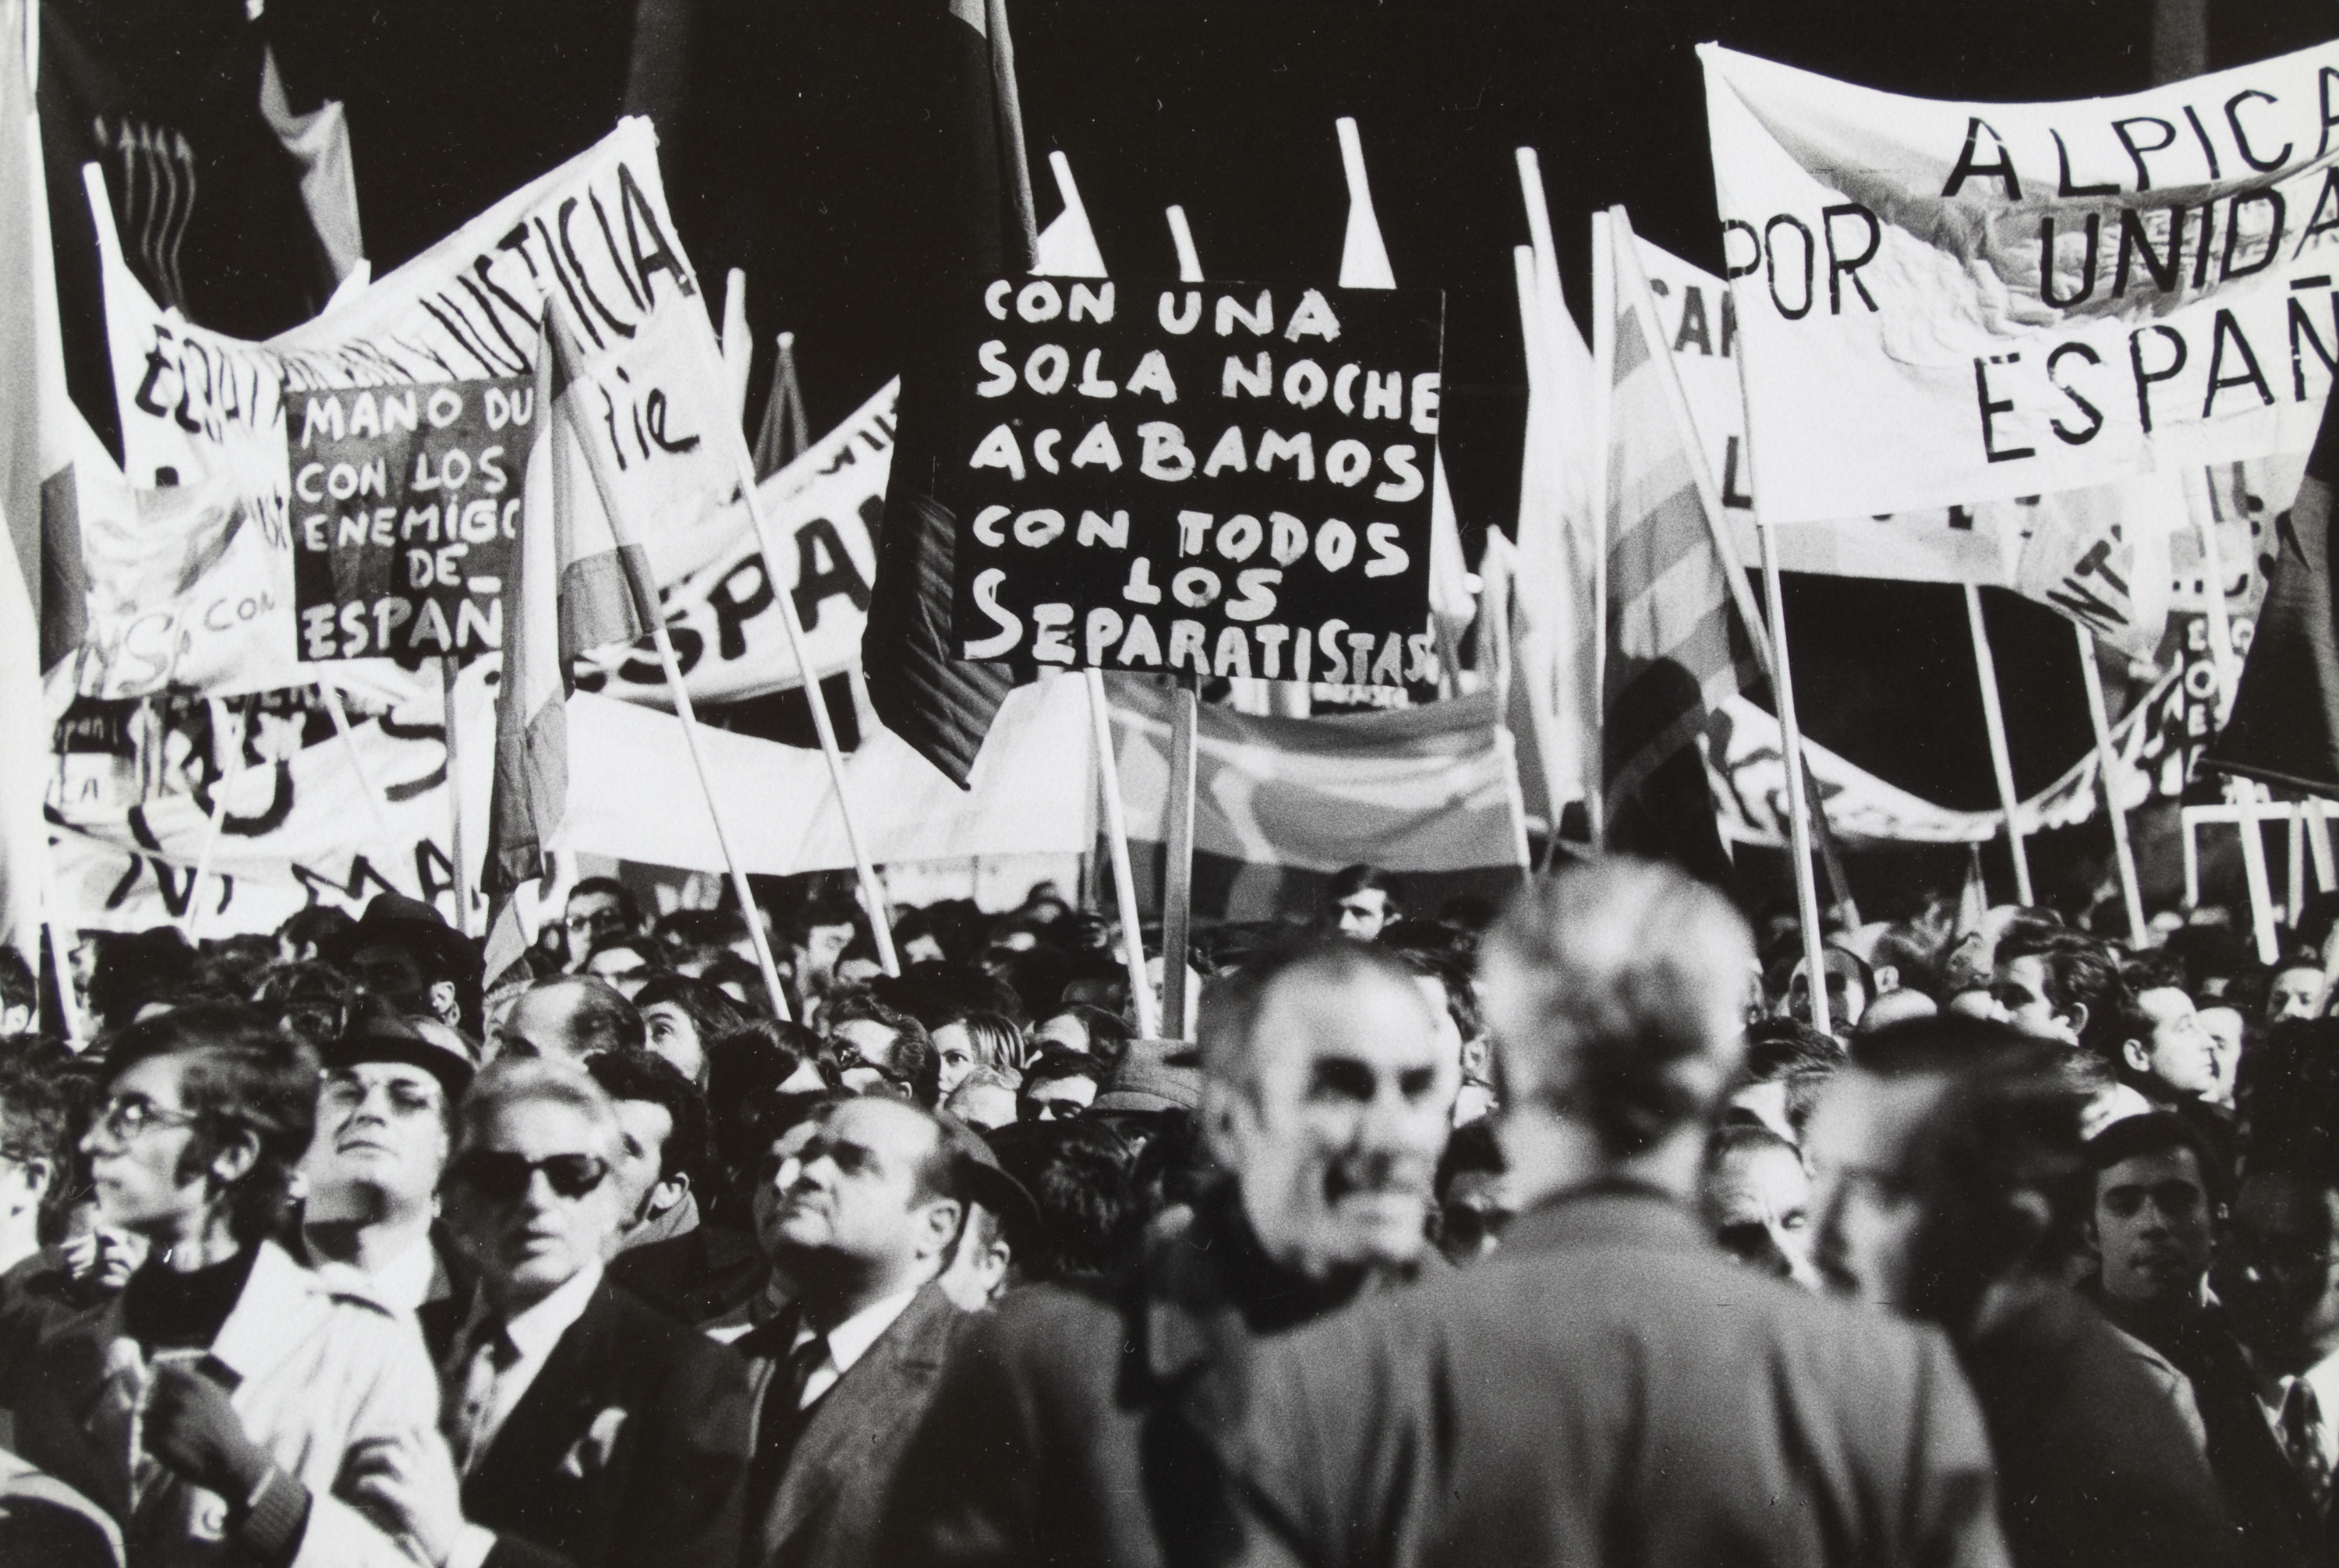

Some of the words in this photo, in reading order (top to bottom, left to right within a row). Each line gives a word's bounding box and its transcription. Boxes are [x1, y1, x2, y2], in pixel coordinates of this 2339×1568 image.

[1722, 203, 1881, 320] POR
[985, 279, 1115, 324] CON
[1158, 288, 1340, 342] UNA
[301, 388, 463, 450] MANO
[976, 339, 1177, 404] SOLA
[1221, 350, 1441, 434] NOCHE
[295, 456, 387, 503] CON
[411, 444, 508, 494] LOS
[969, 420, 1424, 502] ACABAMOS
[405, 543, 469, 590] DE
[972, 504, 1130, 549] CON
[1177, 509, 1410, 578] TODOS
[1123, 556, 1283, 621] LOS
[964, 567, 1438, 687] SEPARATISTAS
